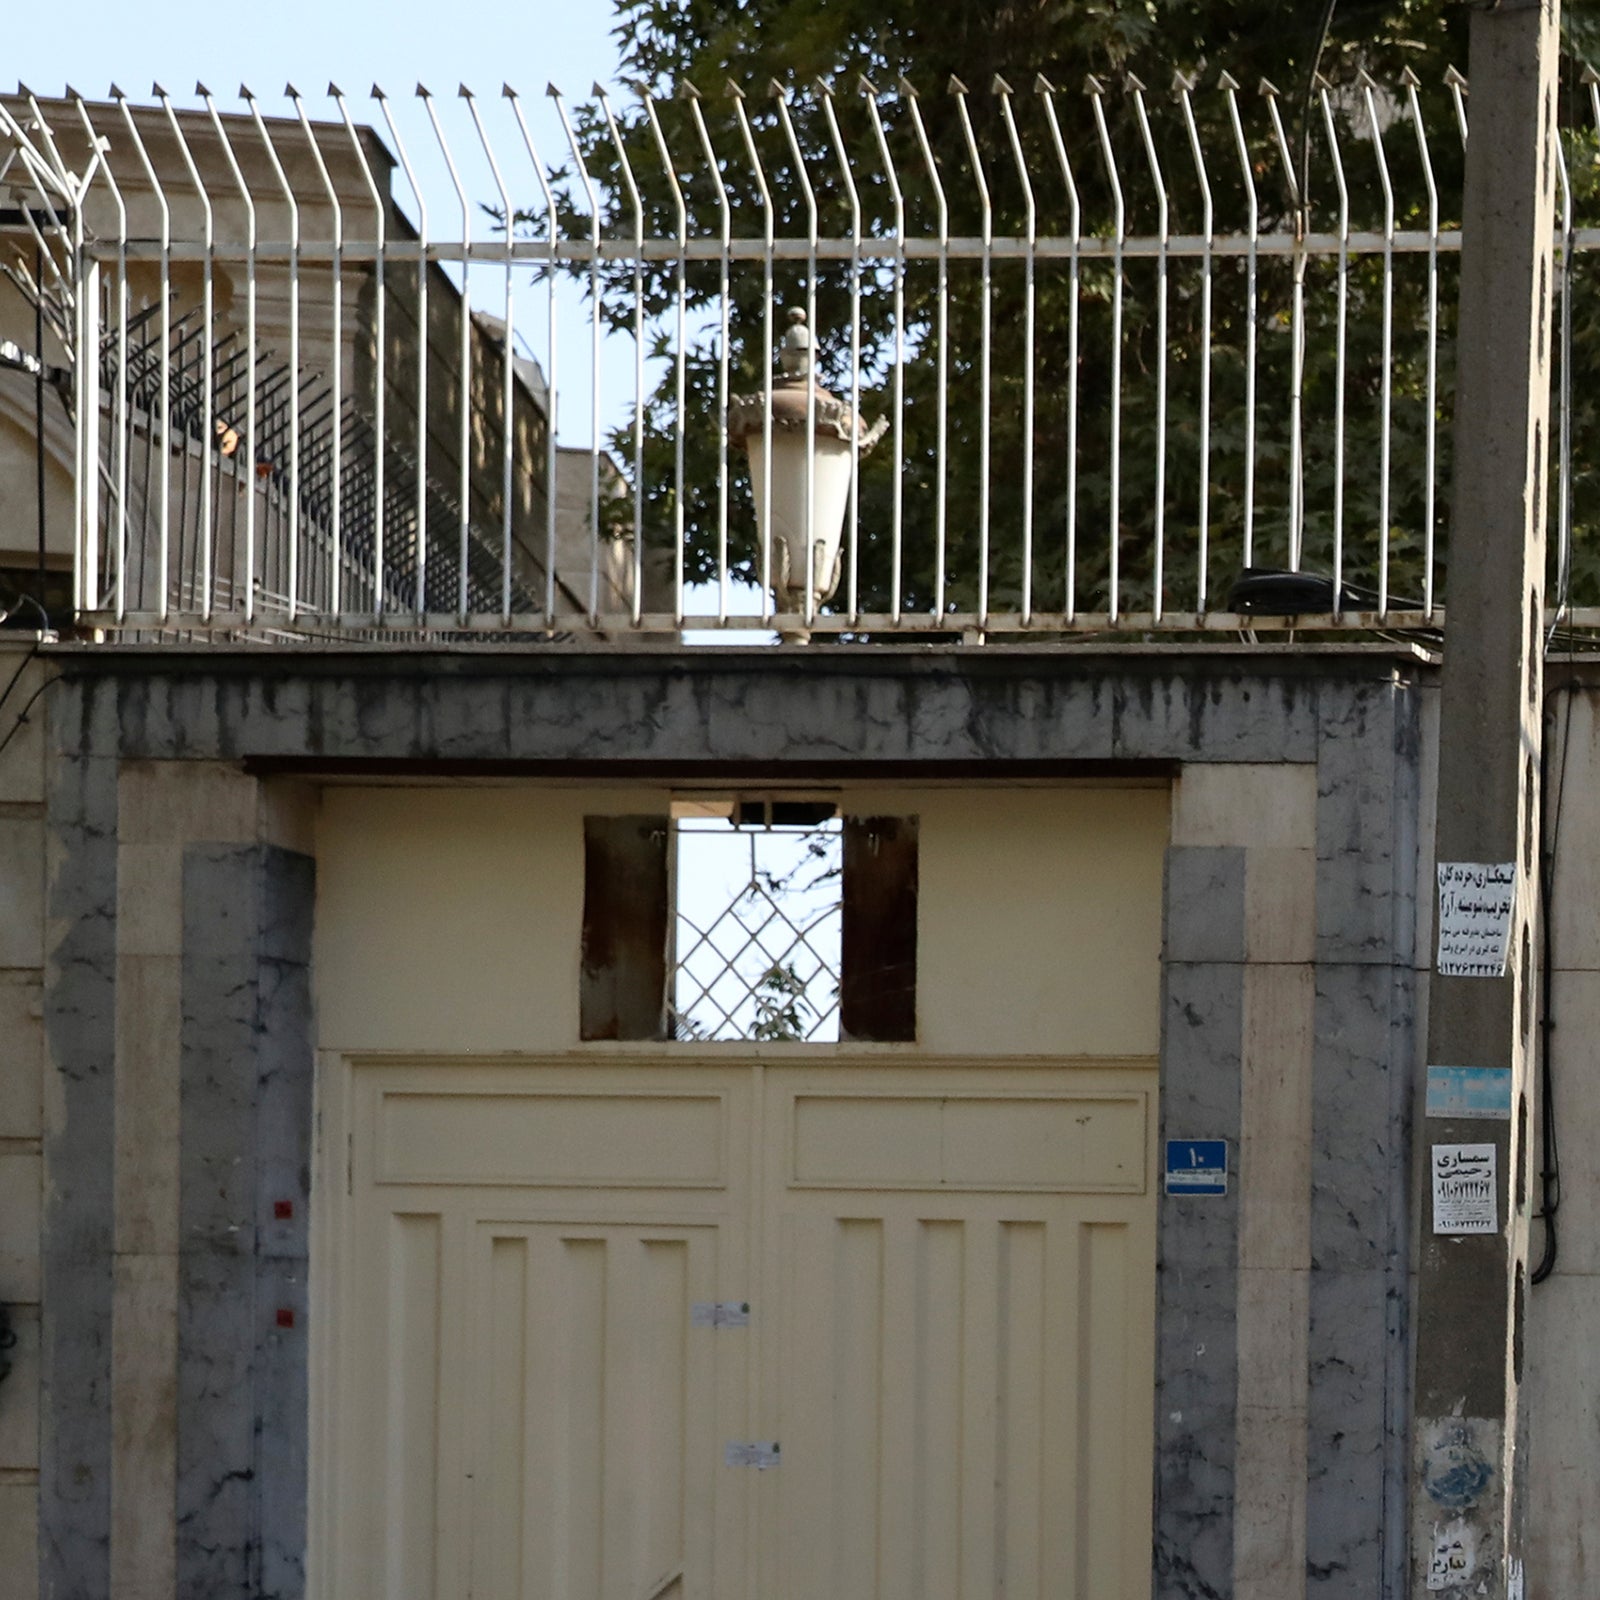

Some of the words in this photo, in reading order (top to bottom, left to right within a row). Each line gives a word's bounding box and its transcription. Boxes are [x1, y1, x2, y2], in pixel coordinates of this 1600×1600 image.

[1189, 1147, 1205, 1168] ۱۰
[1437, 1151, 1490, 1168] سمساری
[1438, 1167, 1492, 1179] رحیمی
